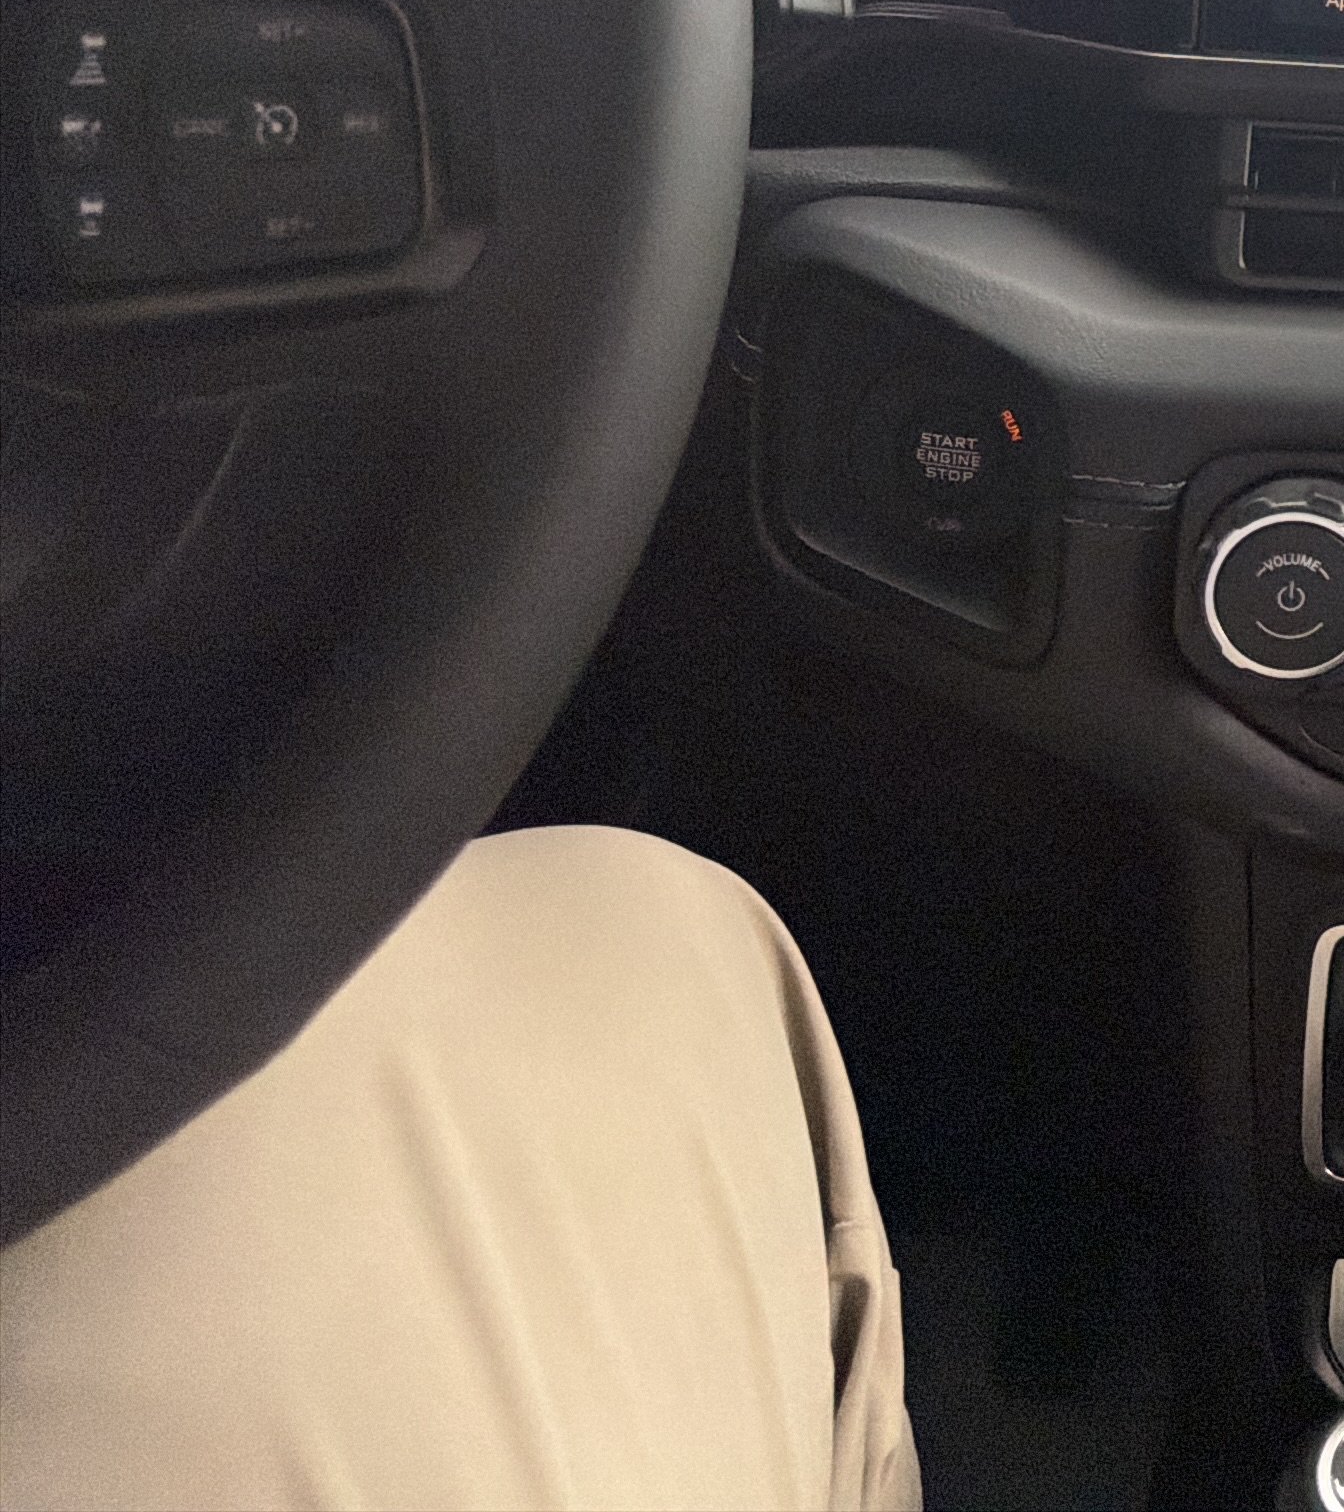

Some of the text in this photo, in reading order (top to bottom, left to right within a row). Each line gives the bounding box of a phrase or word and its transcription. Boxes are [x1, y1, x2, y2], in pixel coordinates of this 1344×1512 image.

[1001, 408, 1024, 442] RUN
[921, 432, 978, 450] START
[916, 449, 982, 468] ENGINE
[925, 467, 974, 482] STOP
[1262, 554, 1322, 574] VOLUME
